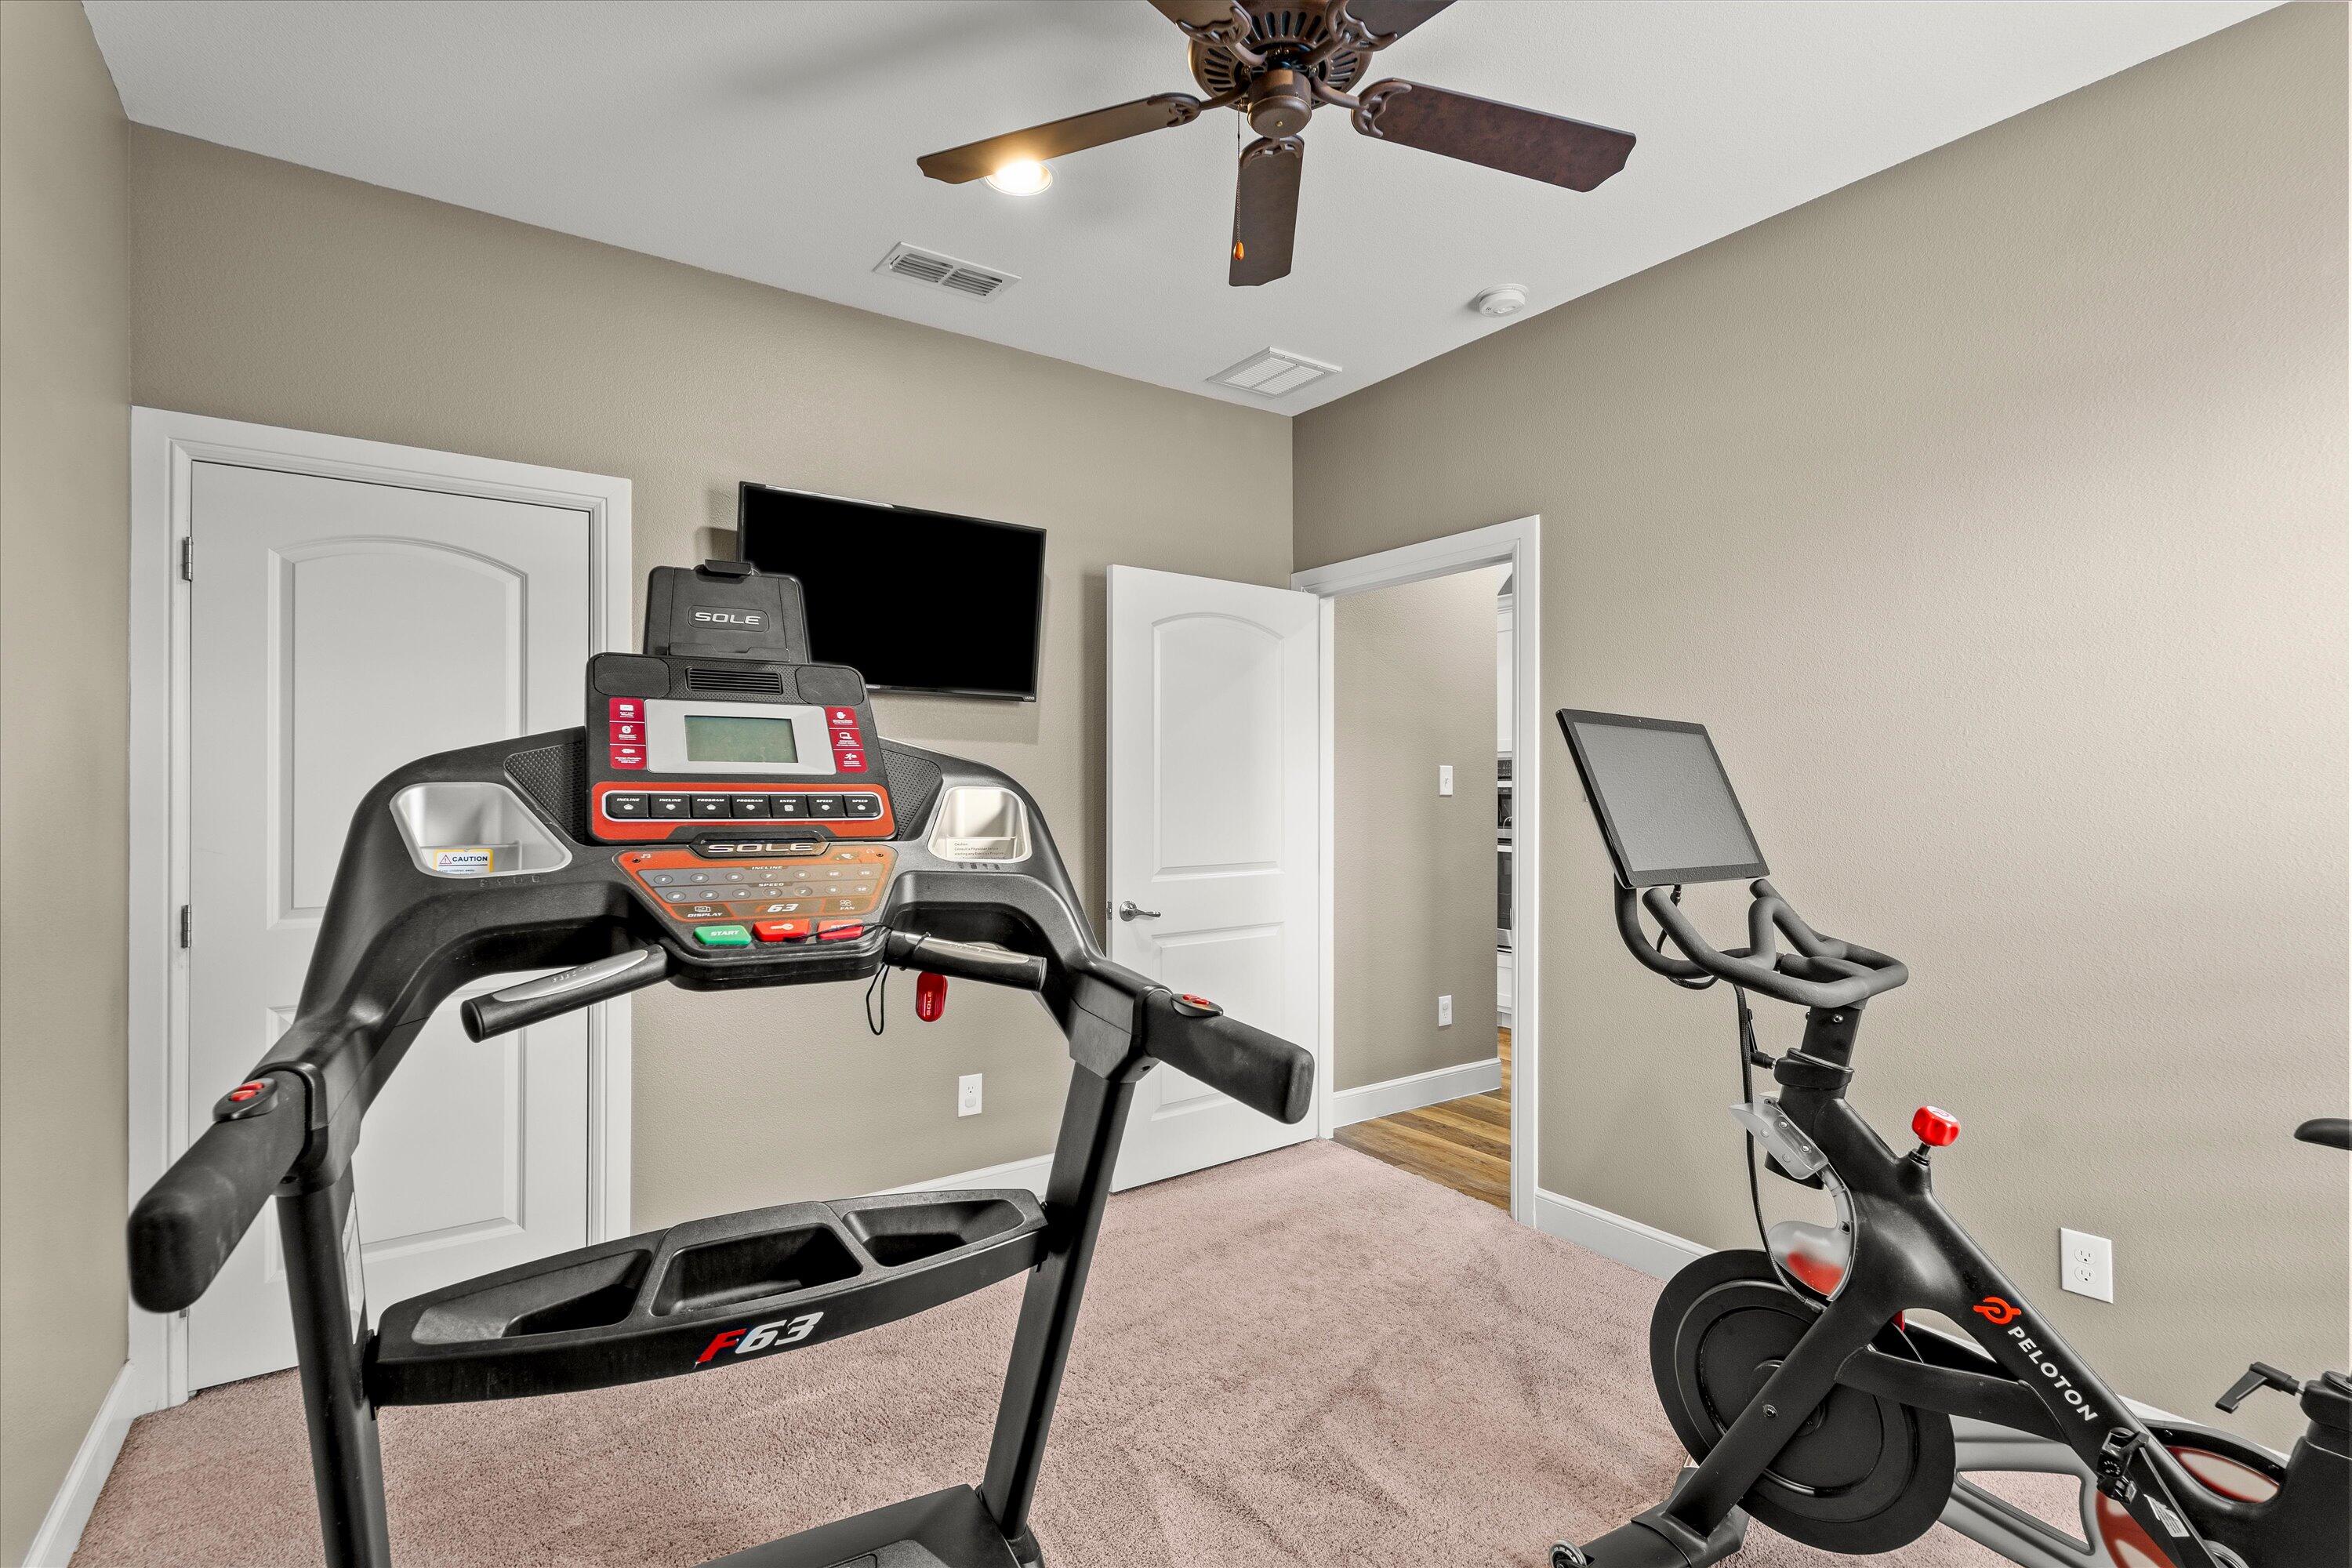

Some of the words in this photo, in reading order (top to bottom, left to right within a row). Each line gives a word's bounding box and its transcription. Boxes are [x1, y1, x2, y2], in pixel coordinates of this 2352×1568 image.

[694, 612, 761, 625] SOLE
[707, 843, 815, 853] SOLE
[754, 903, 799, 913] F63
[693, 1311, 824, 1367] F63
[2007, 1326, 2099, 1421] PELOTON
